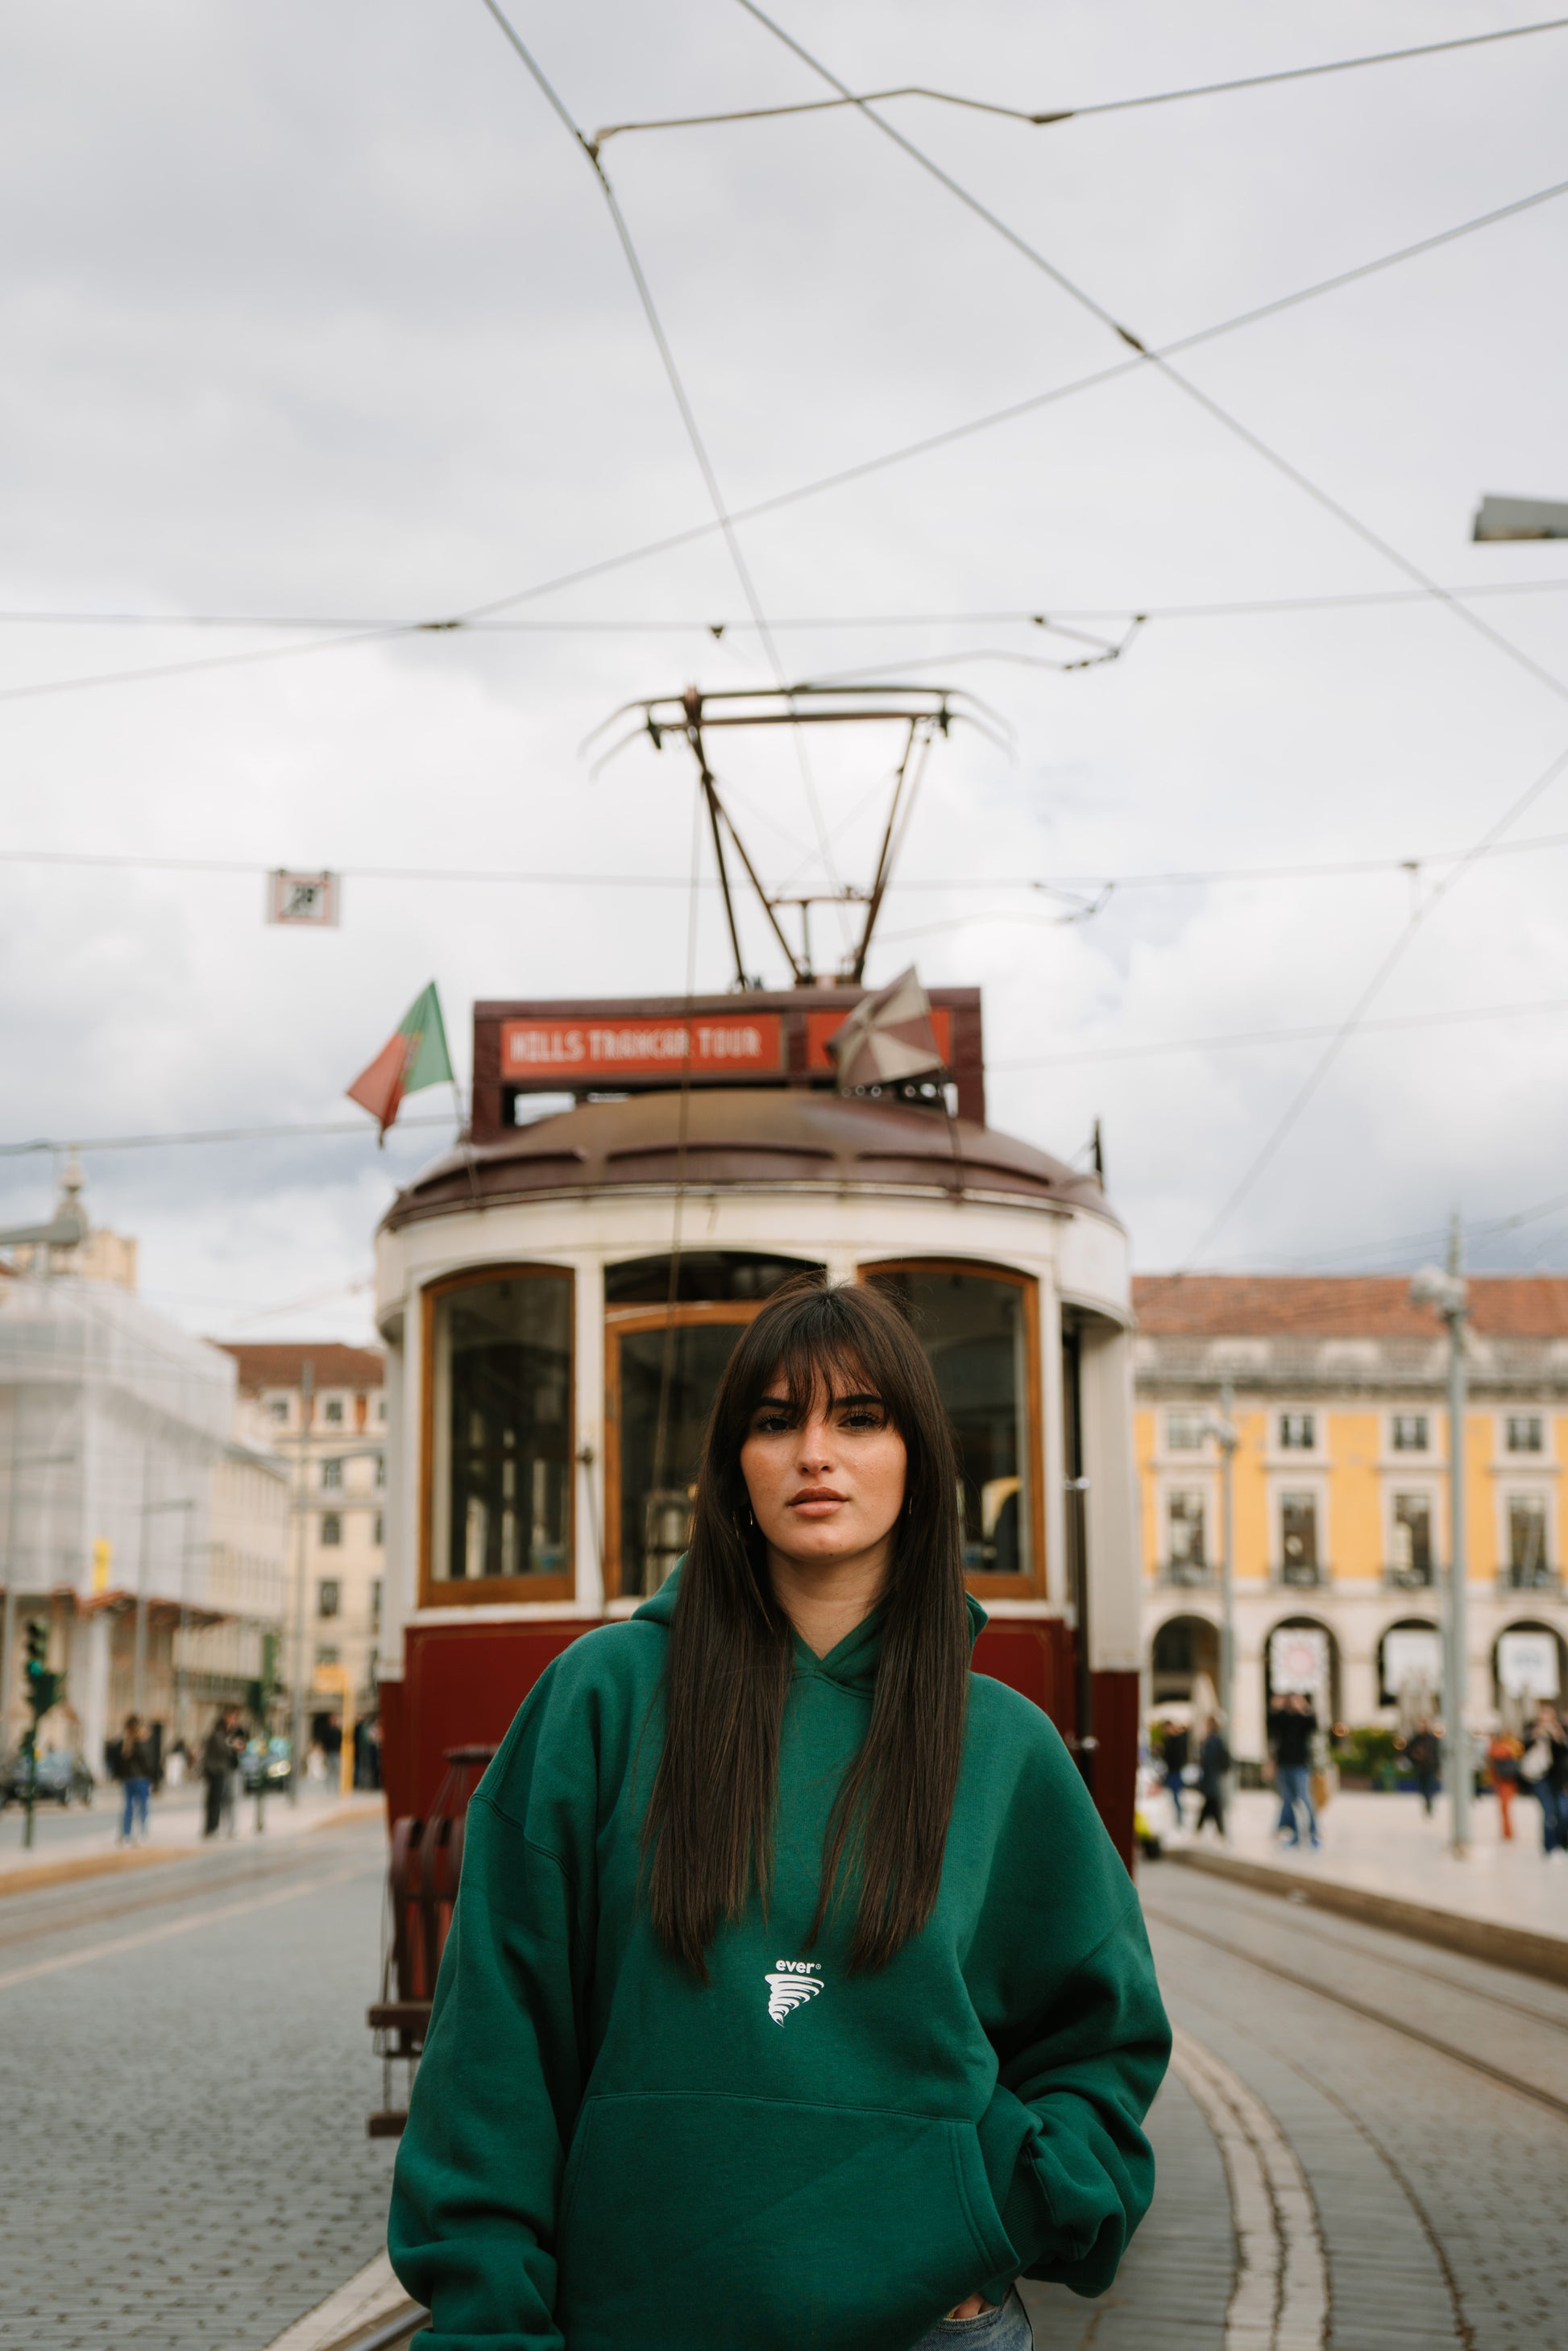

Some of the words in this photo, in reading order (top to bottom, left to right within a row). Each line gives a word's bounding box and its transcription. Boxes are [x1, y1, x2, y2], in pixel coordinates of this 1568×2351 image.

[510, 1030, 585, 1063] HILLS
[587, 1028, 694, 1061] TRAMCAR
[698, 1026, 761, 1059] TOUR
